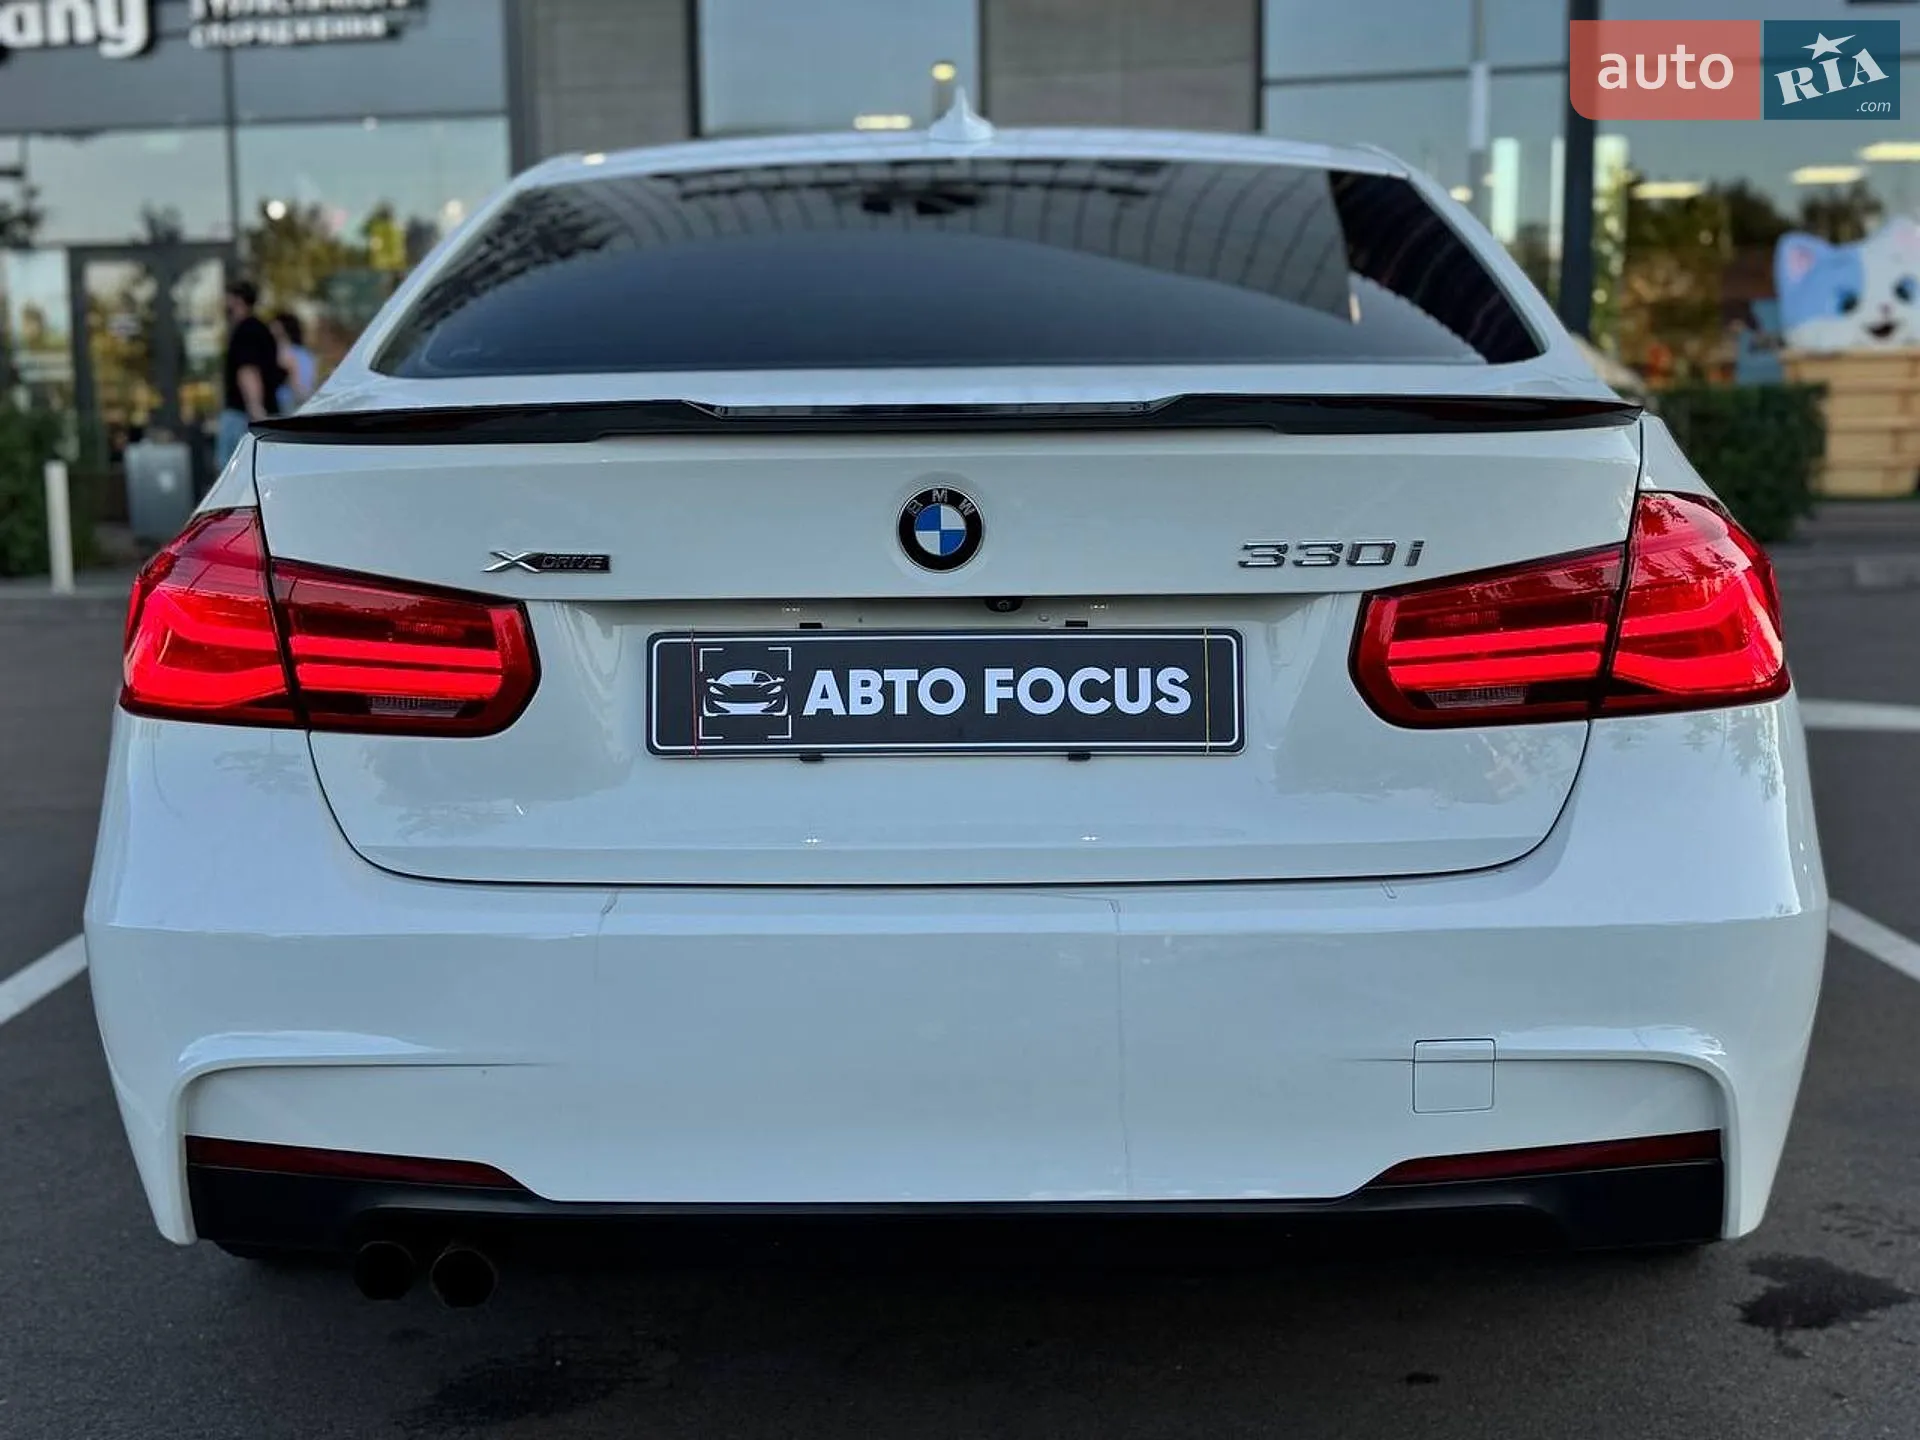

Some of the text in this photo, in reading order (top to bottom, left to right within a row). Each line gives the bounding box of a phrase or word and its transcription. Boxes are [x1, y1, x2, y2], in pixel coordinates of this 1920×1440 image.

[906, 488, 975, 517] BMW
[1238, 539, 1425, 568] 330i
[984, 667, 1192, 716] FOCUS
